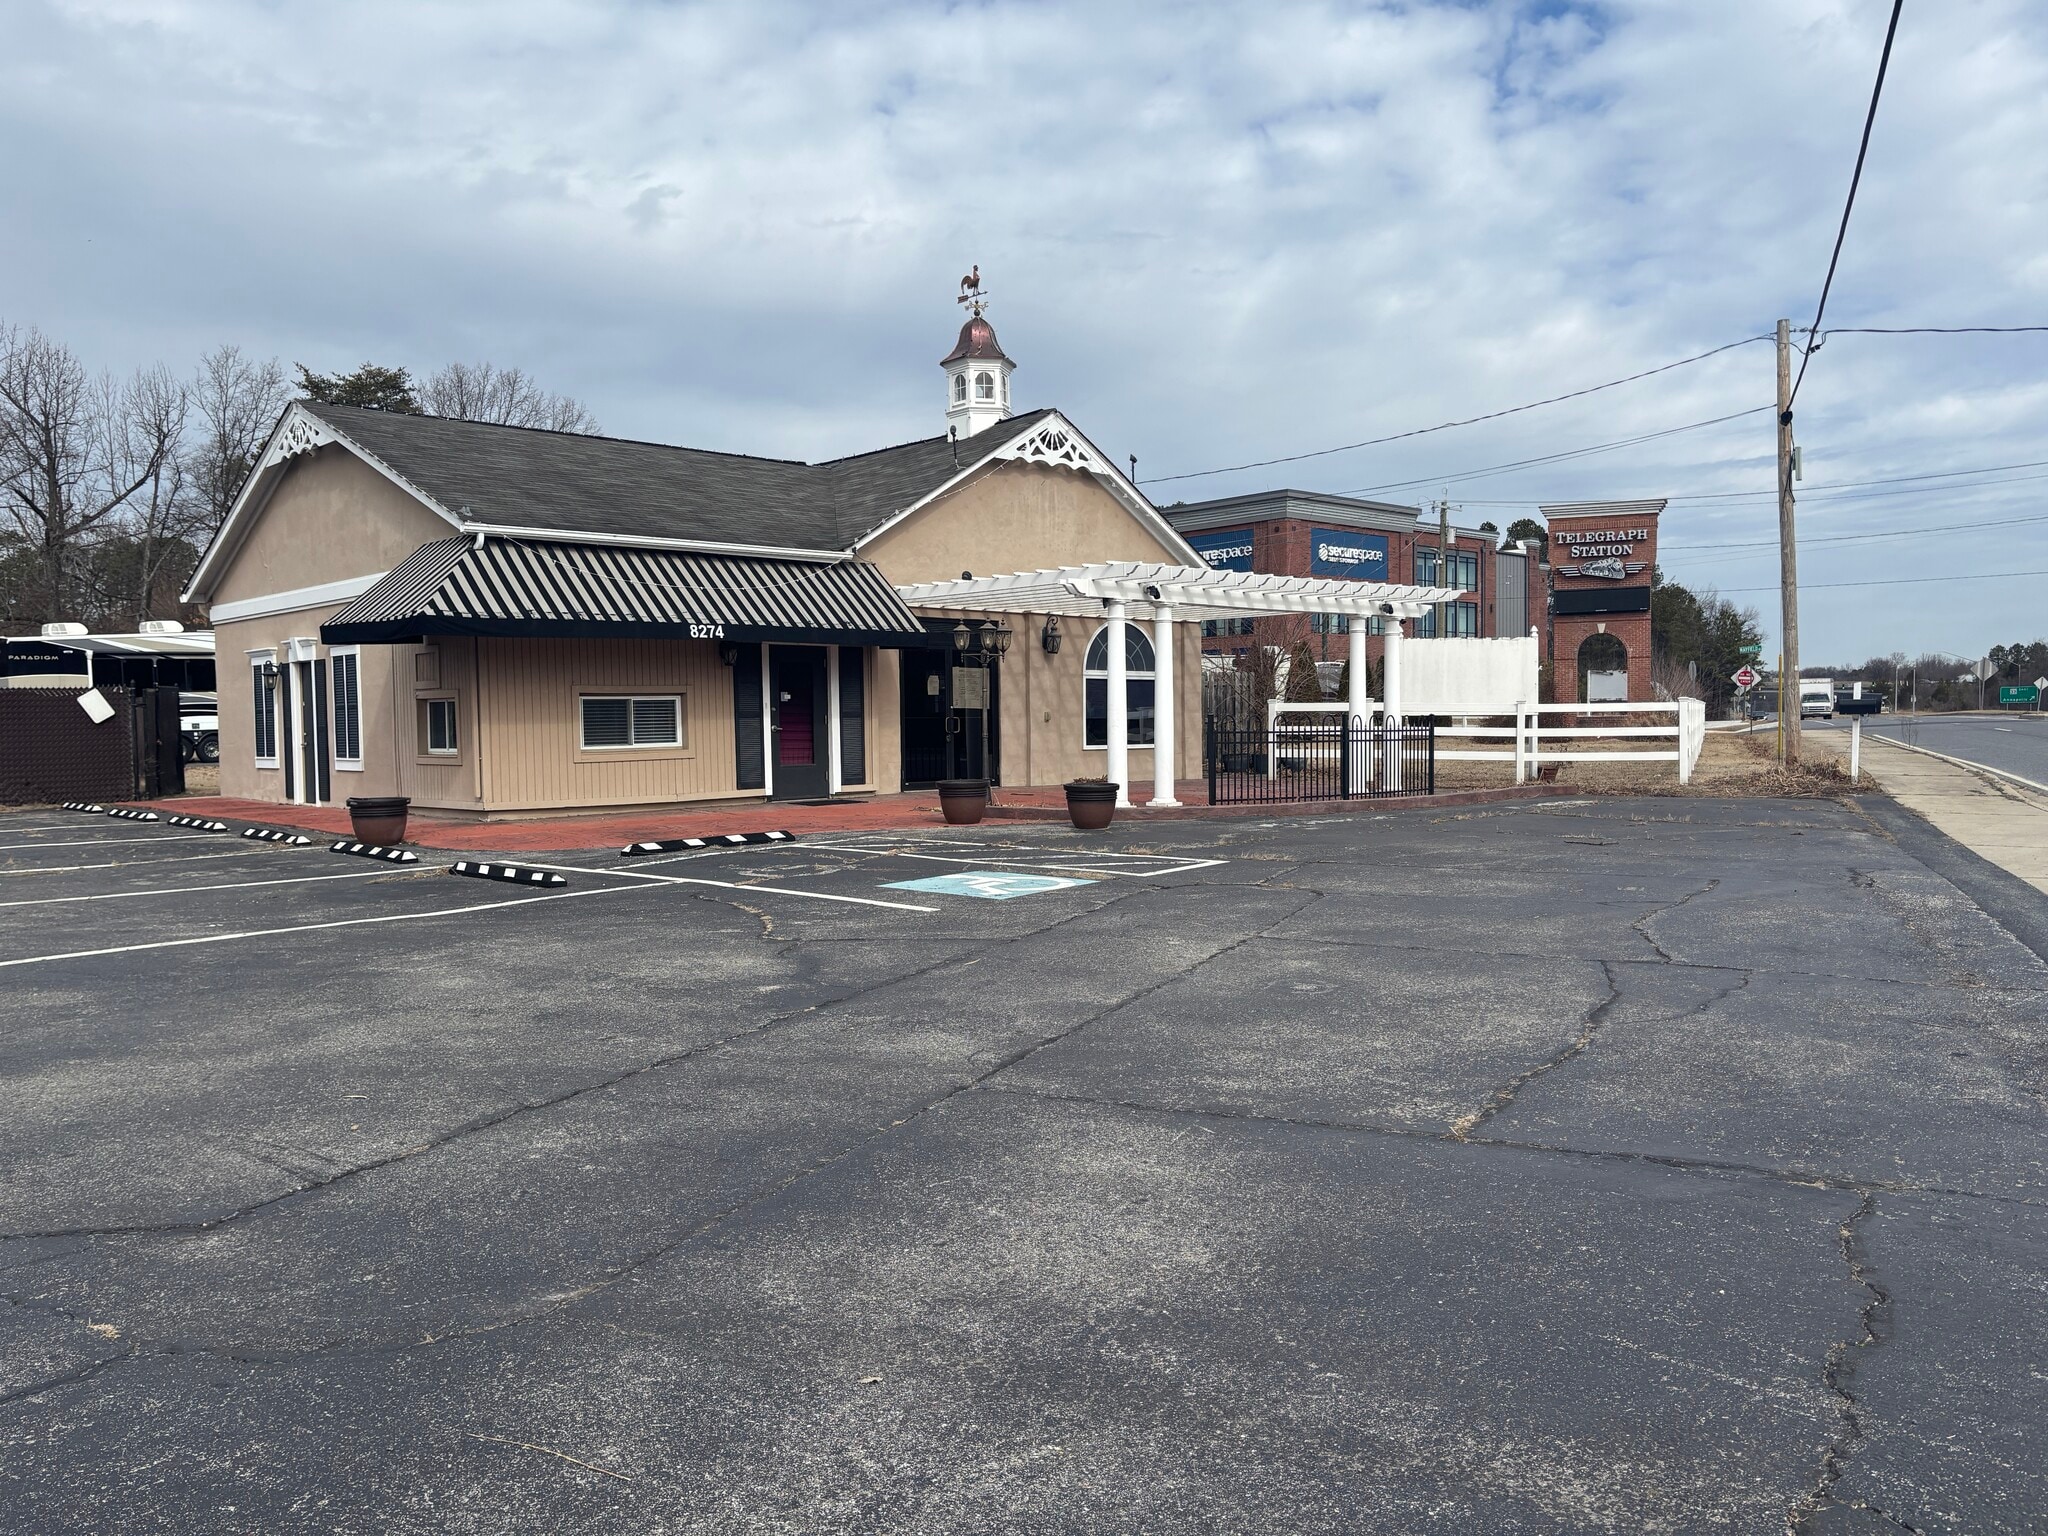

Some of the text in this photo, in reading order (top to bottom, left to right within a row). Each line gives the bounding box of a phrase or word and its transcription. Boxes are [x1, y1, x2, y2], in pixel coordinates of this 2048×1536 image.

[1556, 529, 1648, 544] TELEGRAPH
[1199, 545, 1253, 563] urespace
[1327, 545, 1383, 563] securespace
[1571, 544, 1634, 557] STATION
[690, 625, 724, 639] 8274
